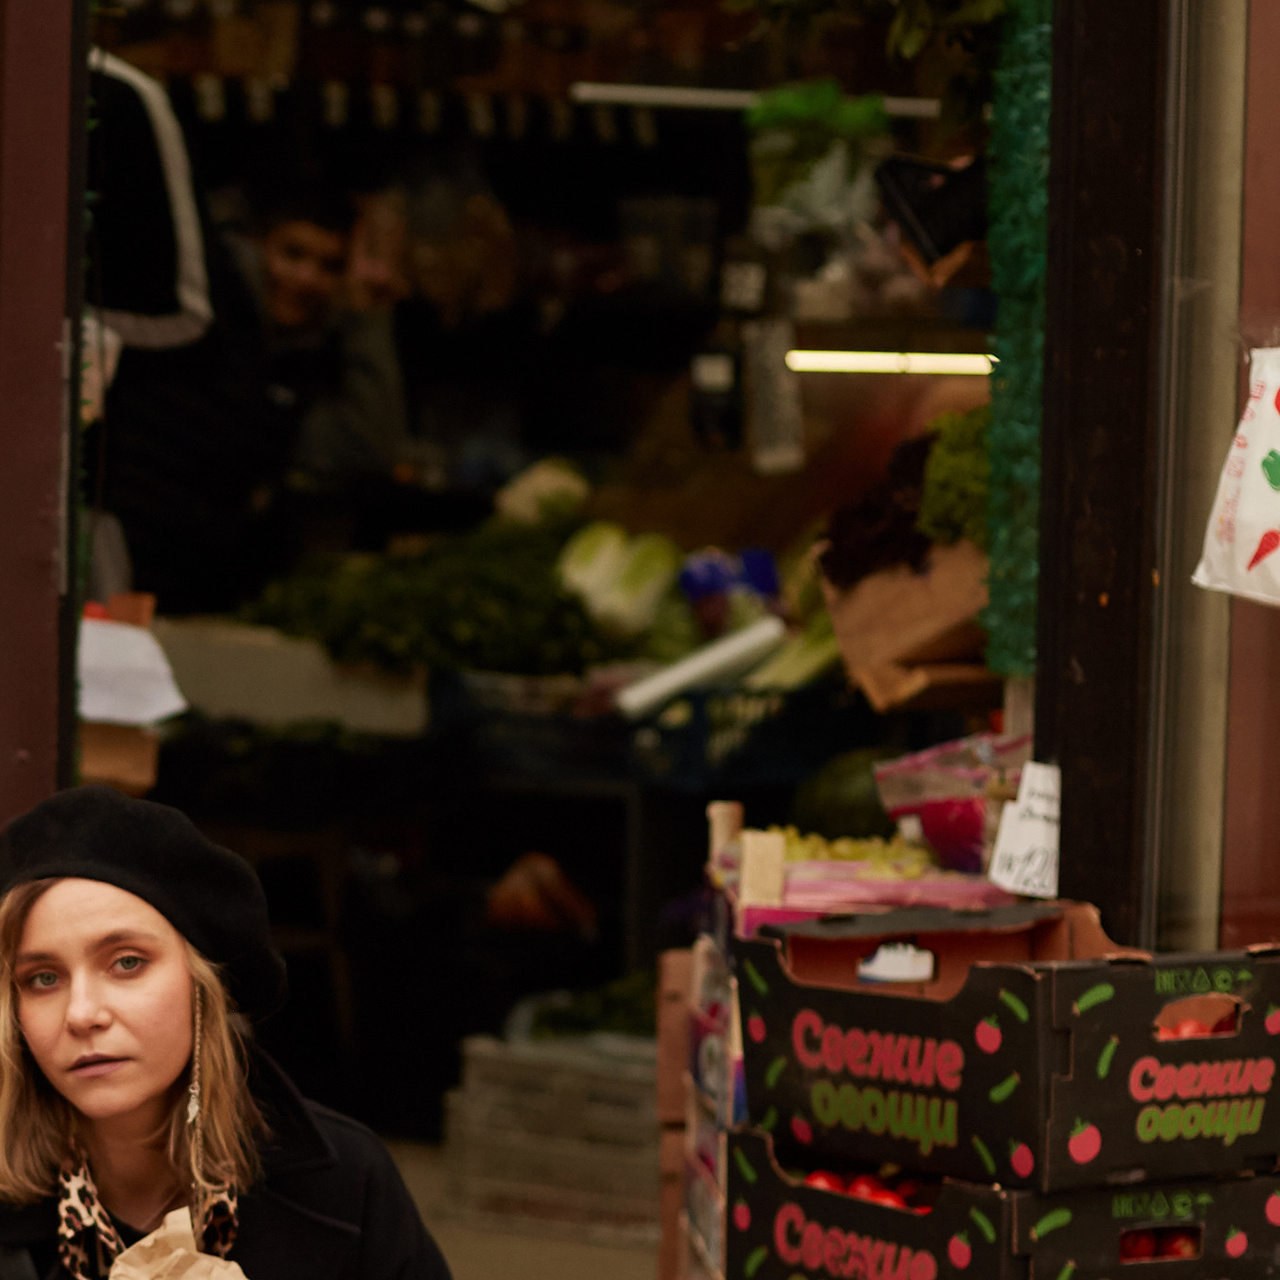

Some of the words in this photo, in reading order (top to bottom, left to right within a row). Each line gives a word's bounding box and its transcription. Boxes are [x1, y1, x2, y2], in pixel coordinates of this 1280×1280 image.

[792, 1008, 965, 1092] Свежие
[1129, 1055, 1276, 1102] Свежие
[810, 1078, 958, 1157] овощи
[1136, 1096, 1266, 1147] овощи
